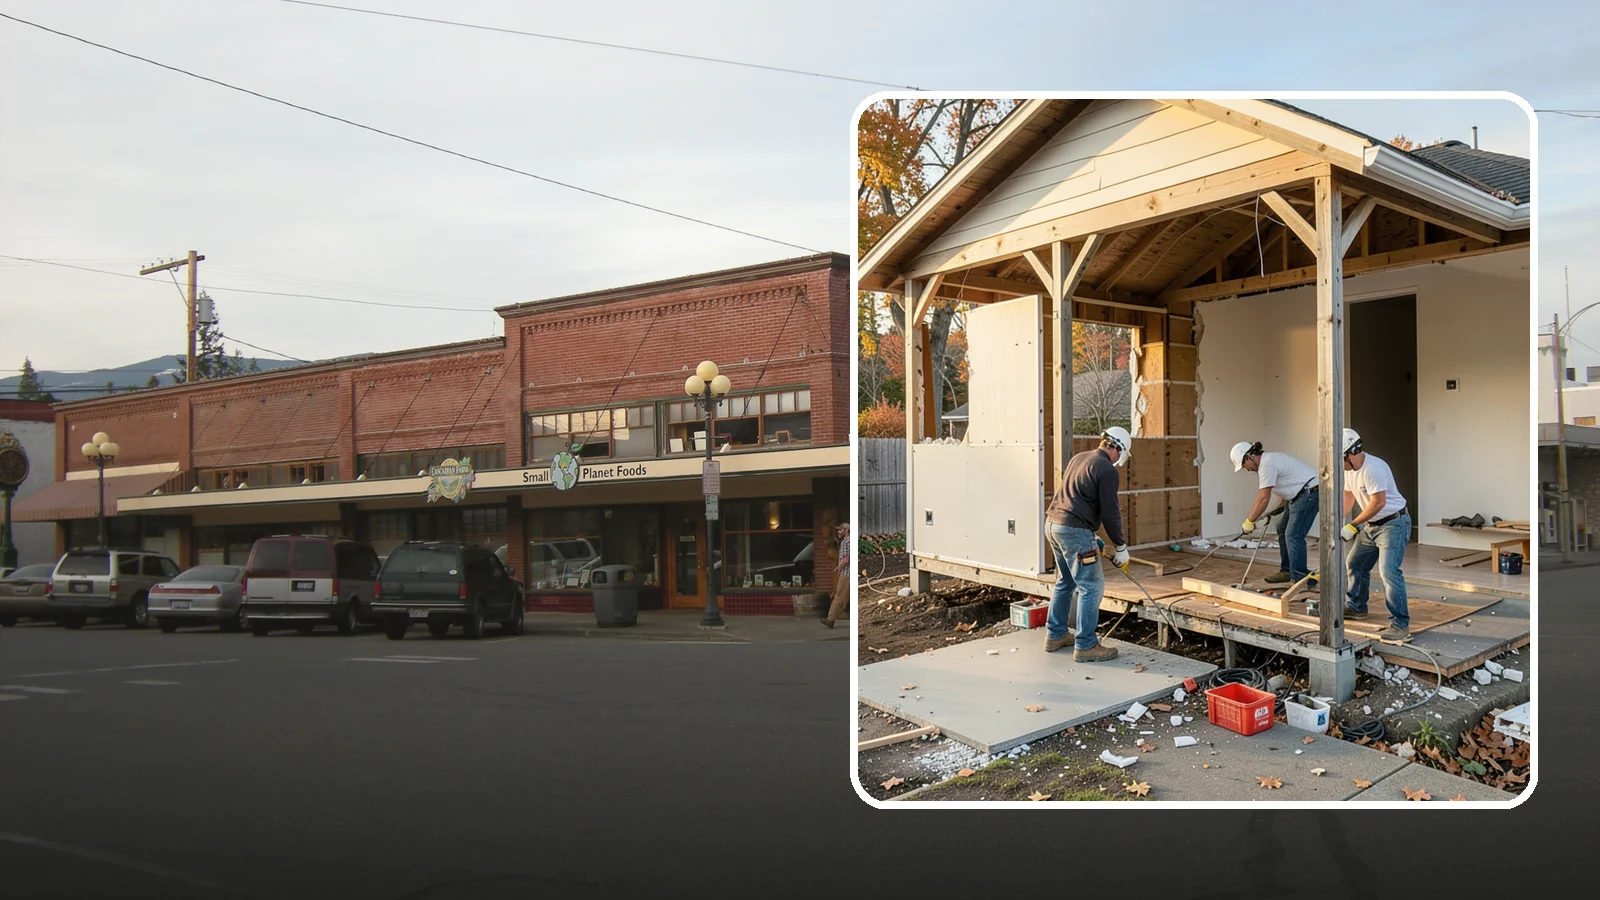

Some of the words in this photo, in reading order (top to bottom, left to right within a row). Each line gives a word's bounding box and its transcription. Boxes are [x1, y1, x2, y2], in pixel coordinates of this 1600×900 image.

[523, 471, 549, 483] Small
[583, 467, 614, 479] Planet
[617, 465, 647, 477] Foods
